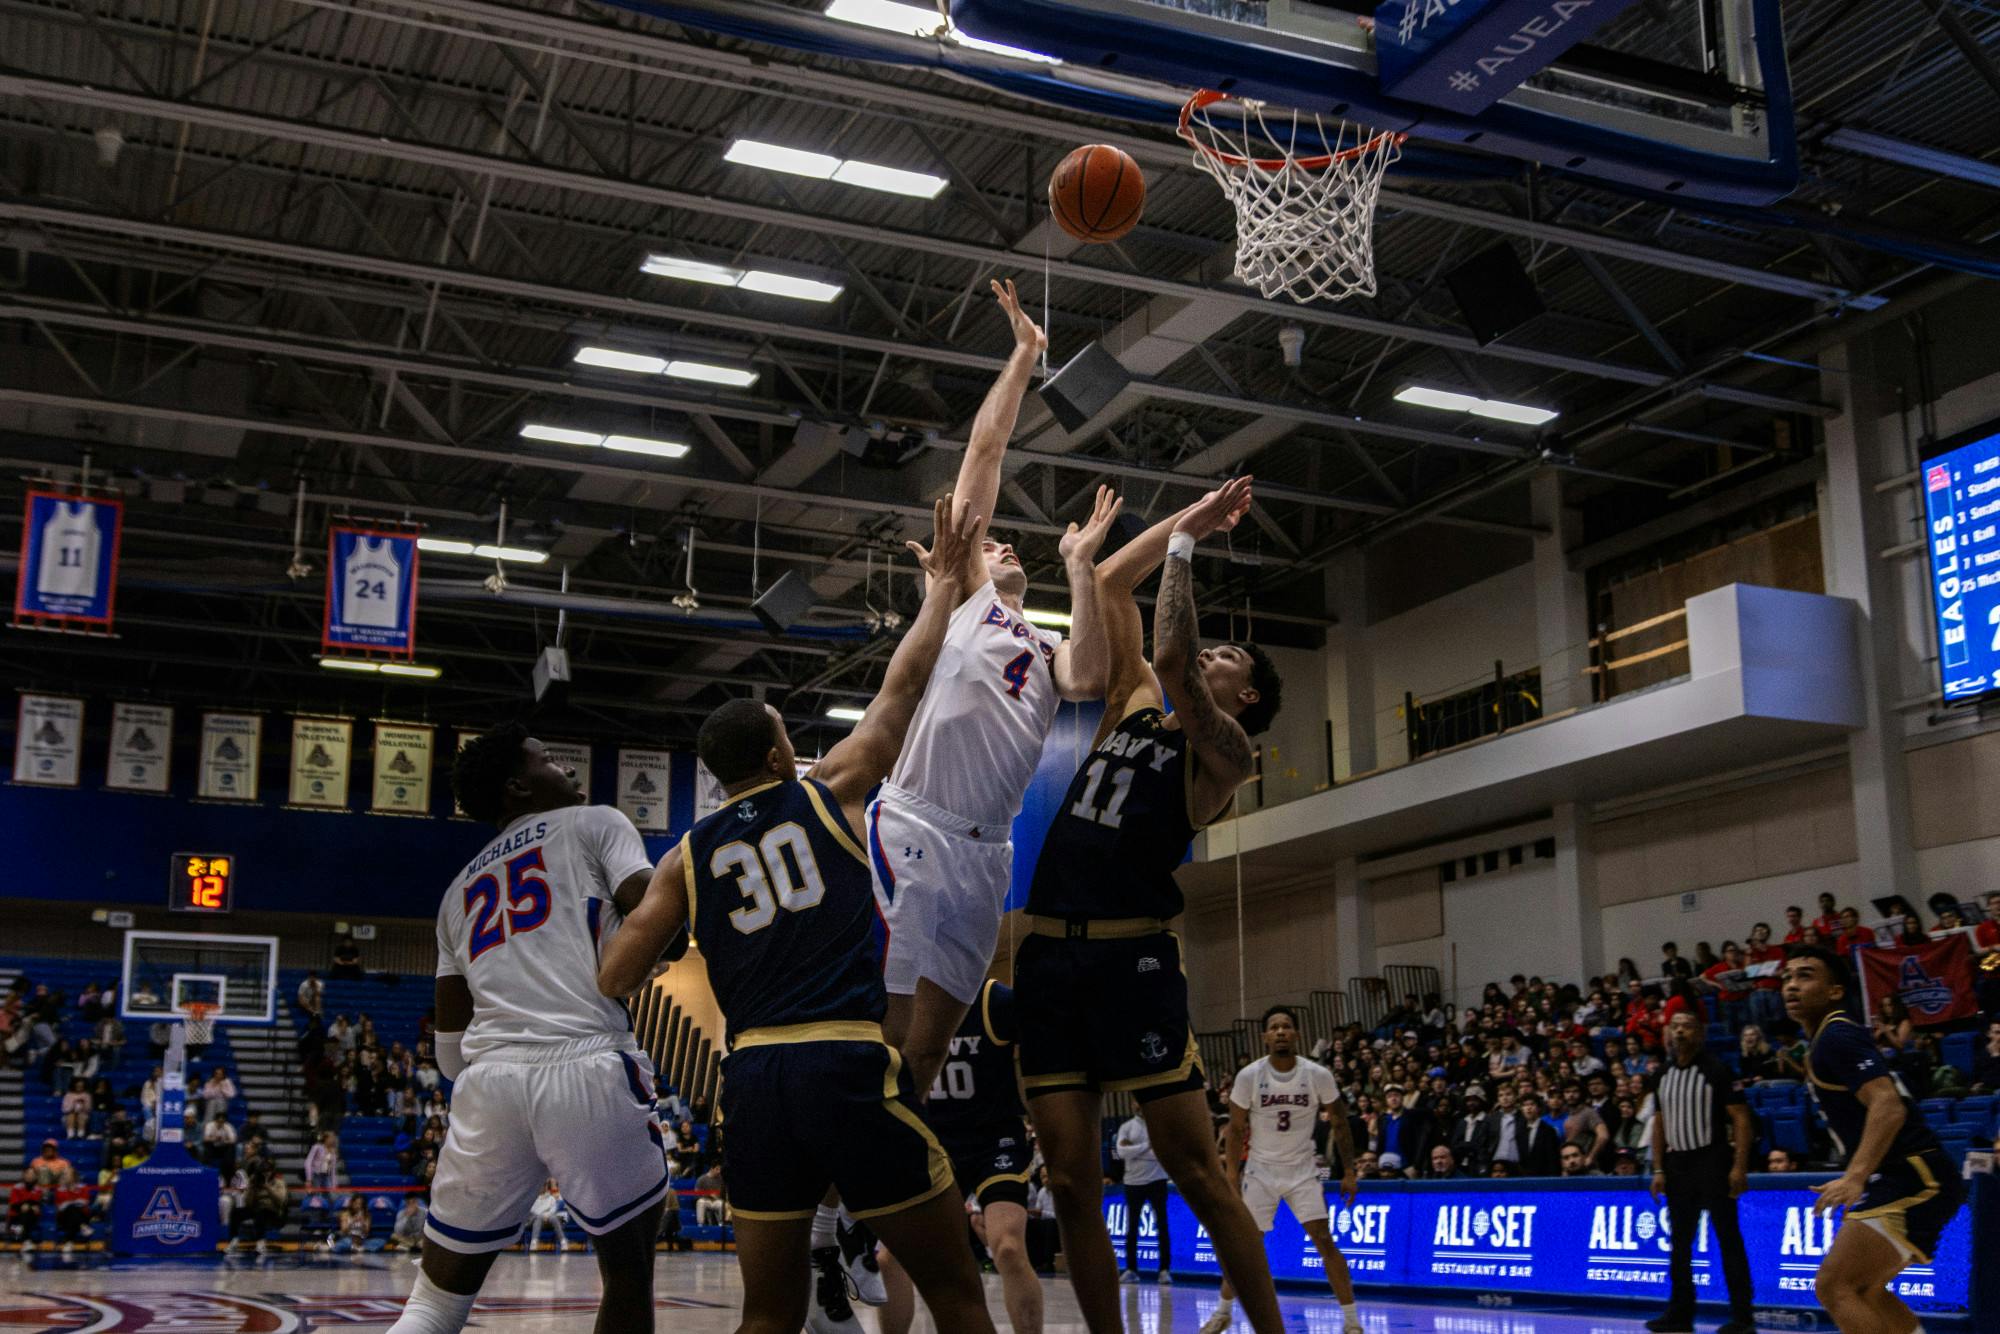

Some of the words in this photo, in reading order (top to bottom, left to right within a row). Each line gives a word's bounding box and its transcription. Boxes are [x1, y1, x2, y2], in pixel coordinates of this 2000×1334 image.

[58, 547, 82, 567] 11
[354, 579, 387, 601] 24
[1933, 515, 1965, 646] EAGLES
[1002, 647, 1036, 701] 4
[1097, 730, 1179, 773] NAVY
[1070, 757, 1137, 829] 11
[465, 821, 547, 881] MICHAELS
[192, 876, 224, 908] 12
[709, 820, 826, 936] 30
[462, 845, 552, 965] 25
[949, 1035, 982, 1056] VY
[929, 1060, 975, 1100] 10
[1260, 1094, 1310, 1108] EAGLES
[1277, 1110, 1291, 1132] 3
[1351, 1204, 1390, 1243] SET
[1433, 1205, 1475, 1247] ALL
[1490, 1205, 1537, 1248] SET
[1588, 1205, 1638, 1250] ALL
[1431, 1262, 1497, 1276] RESTAURANT
[1499, 1265, 1507, 1276] &
[1509, 1265, 1533, 1278] BAR
[1586, 1268, 1668, 1284] RESTAURANT
[1691, 1273, 1711, 1286] AR
[1898, 1282, 1935, 1298] BAR
